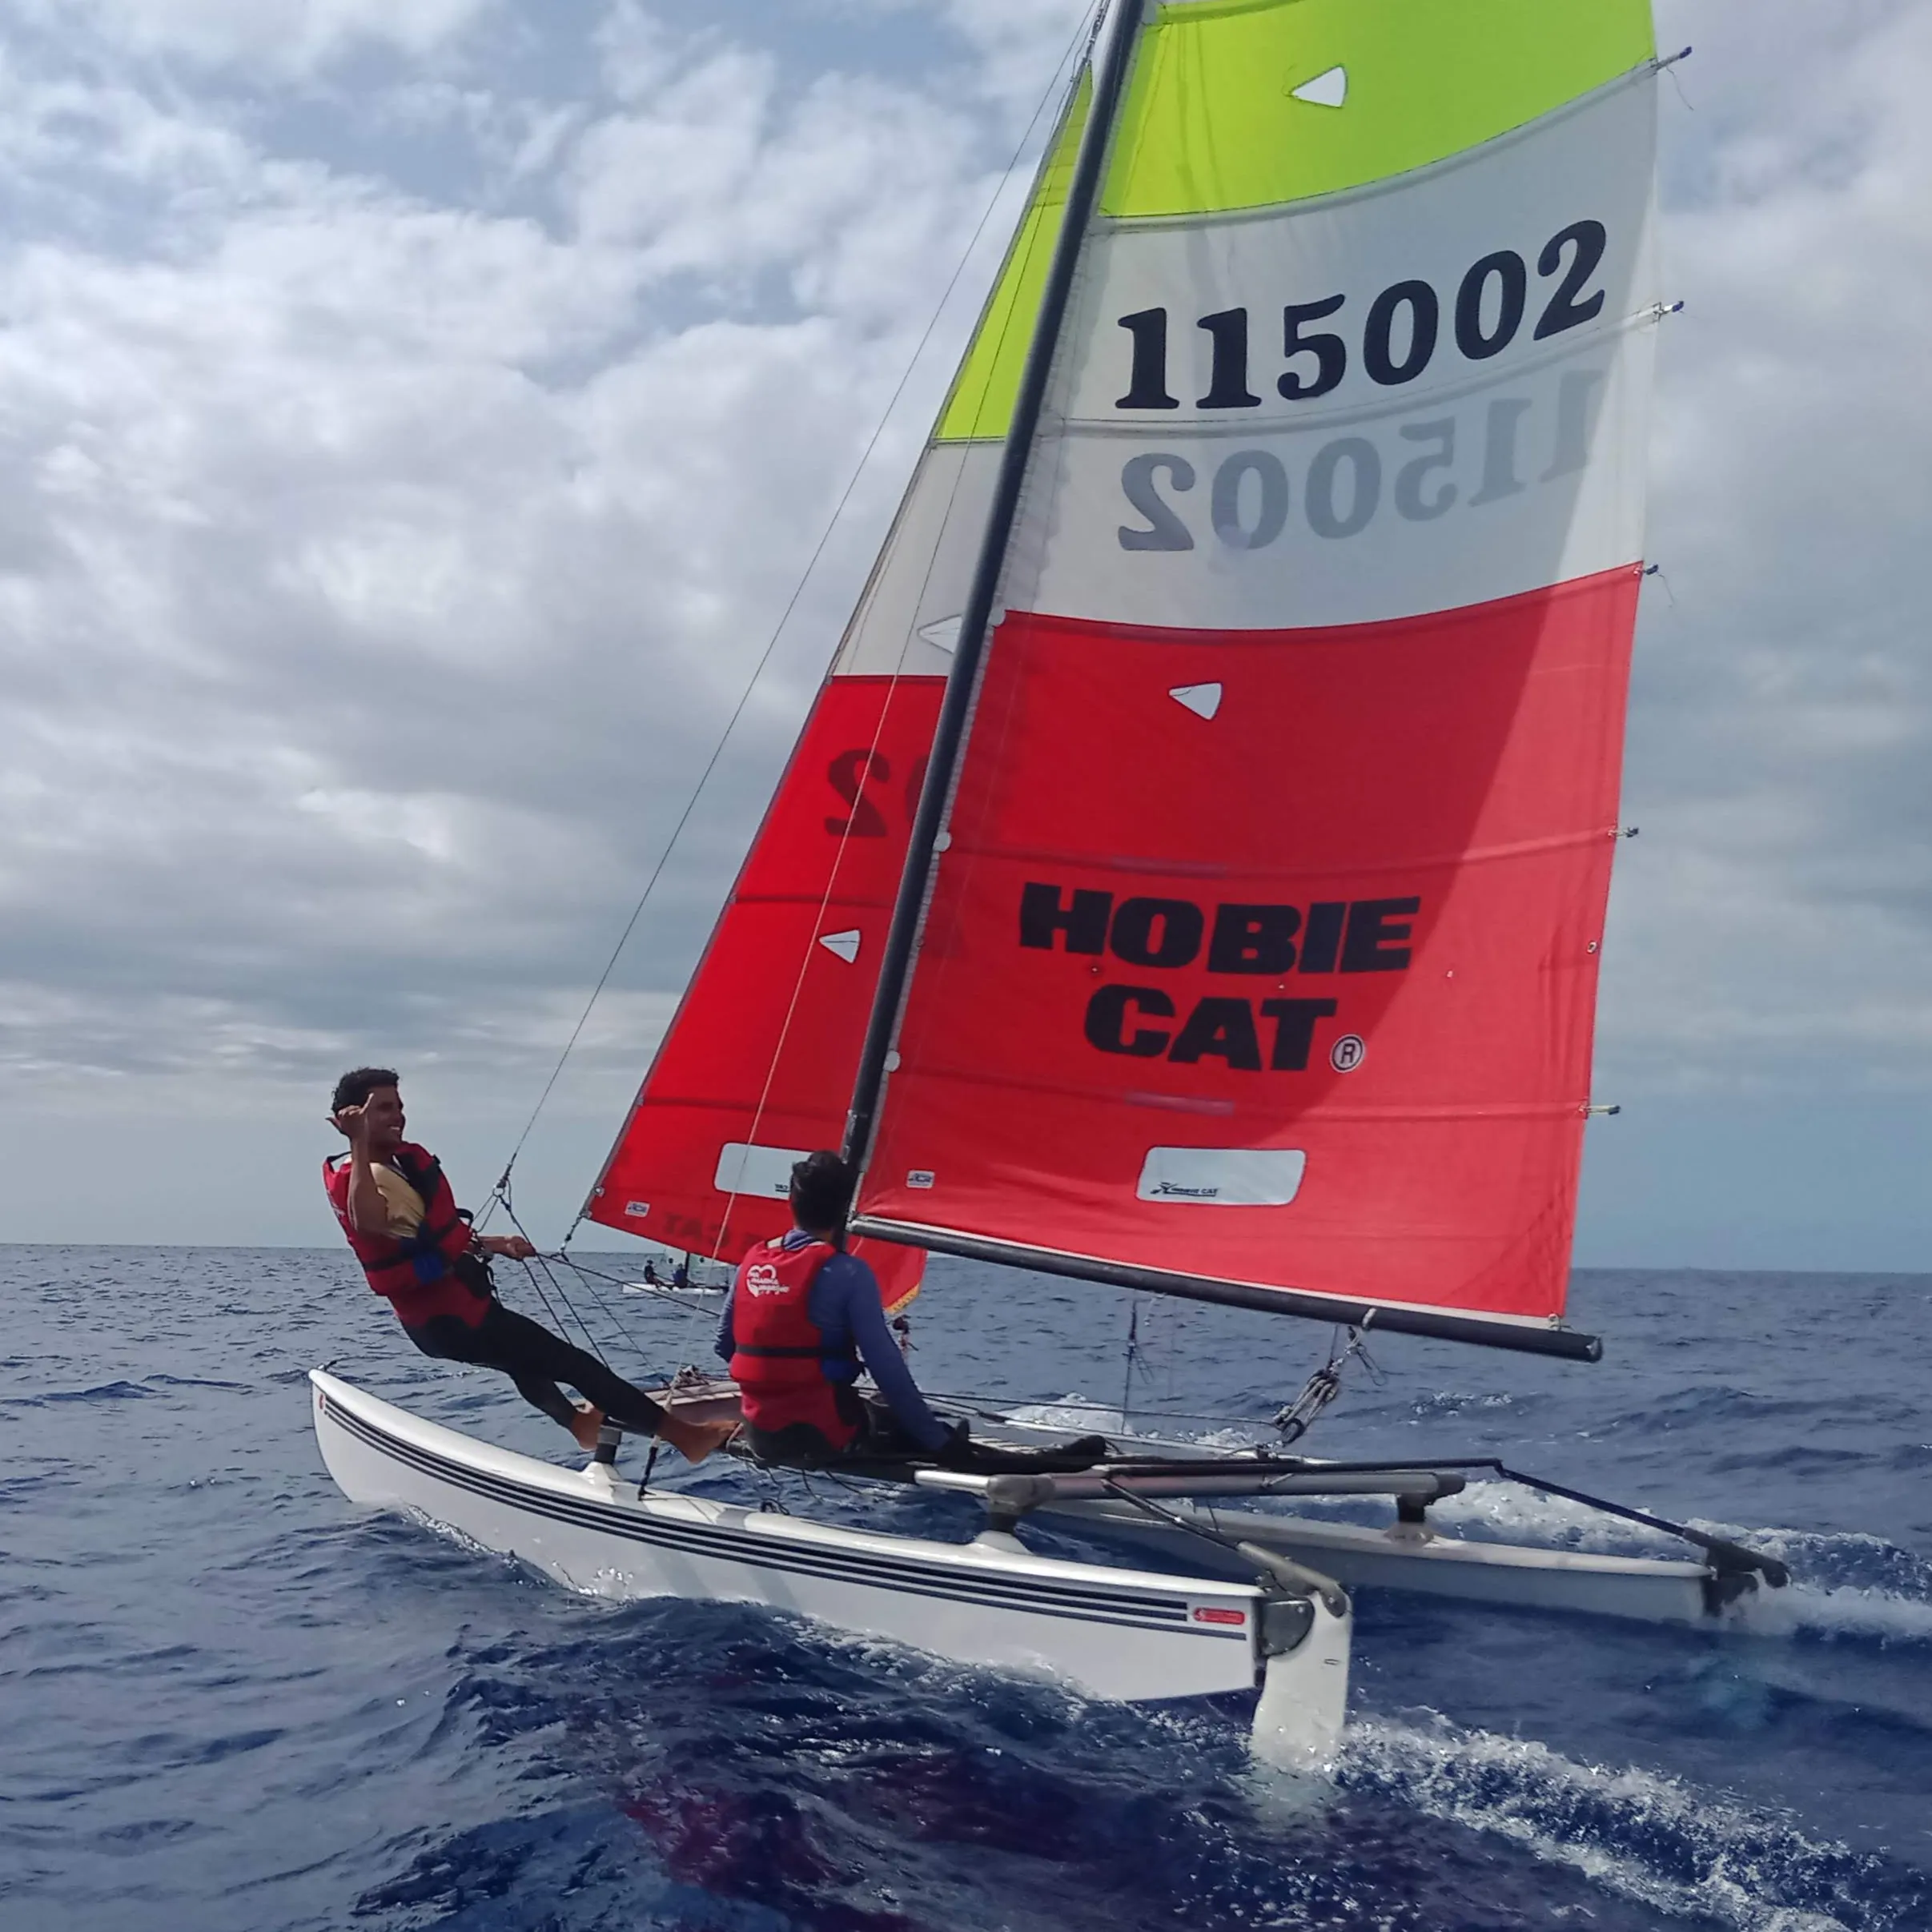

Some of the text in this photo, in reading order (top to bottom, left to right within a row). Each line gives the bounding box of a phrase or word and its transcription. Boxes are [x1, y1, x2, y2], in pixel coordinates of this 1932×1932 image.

[1115, 220, 1606, 409] 115002
[1019, 882, 1421, 974] HOBIE
[1084, 983, 1338, 1071] CAT
